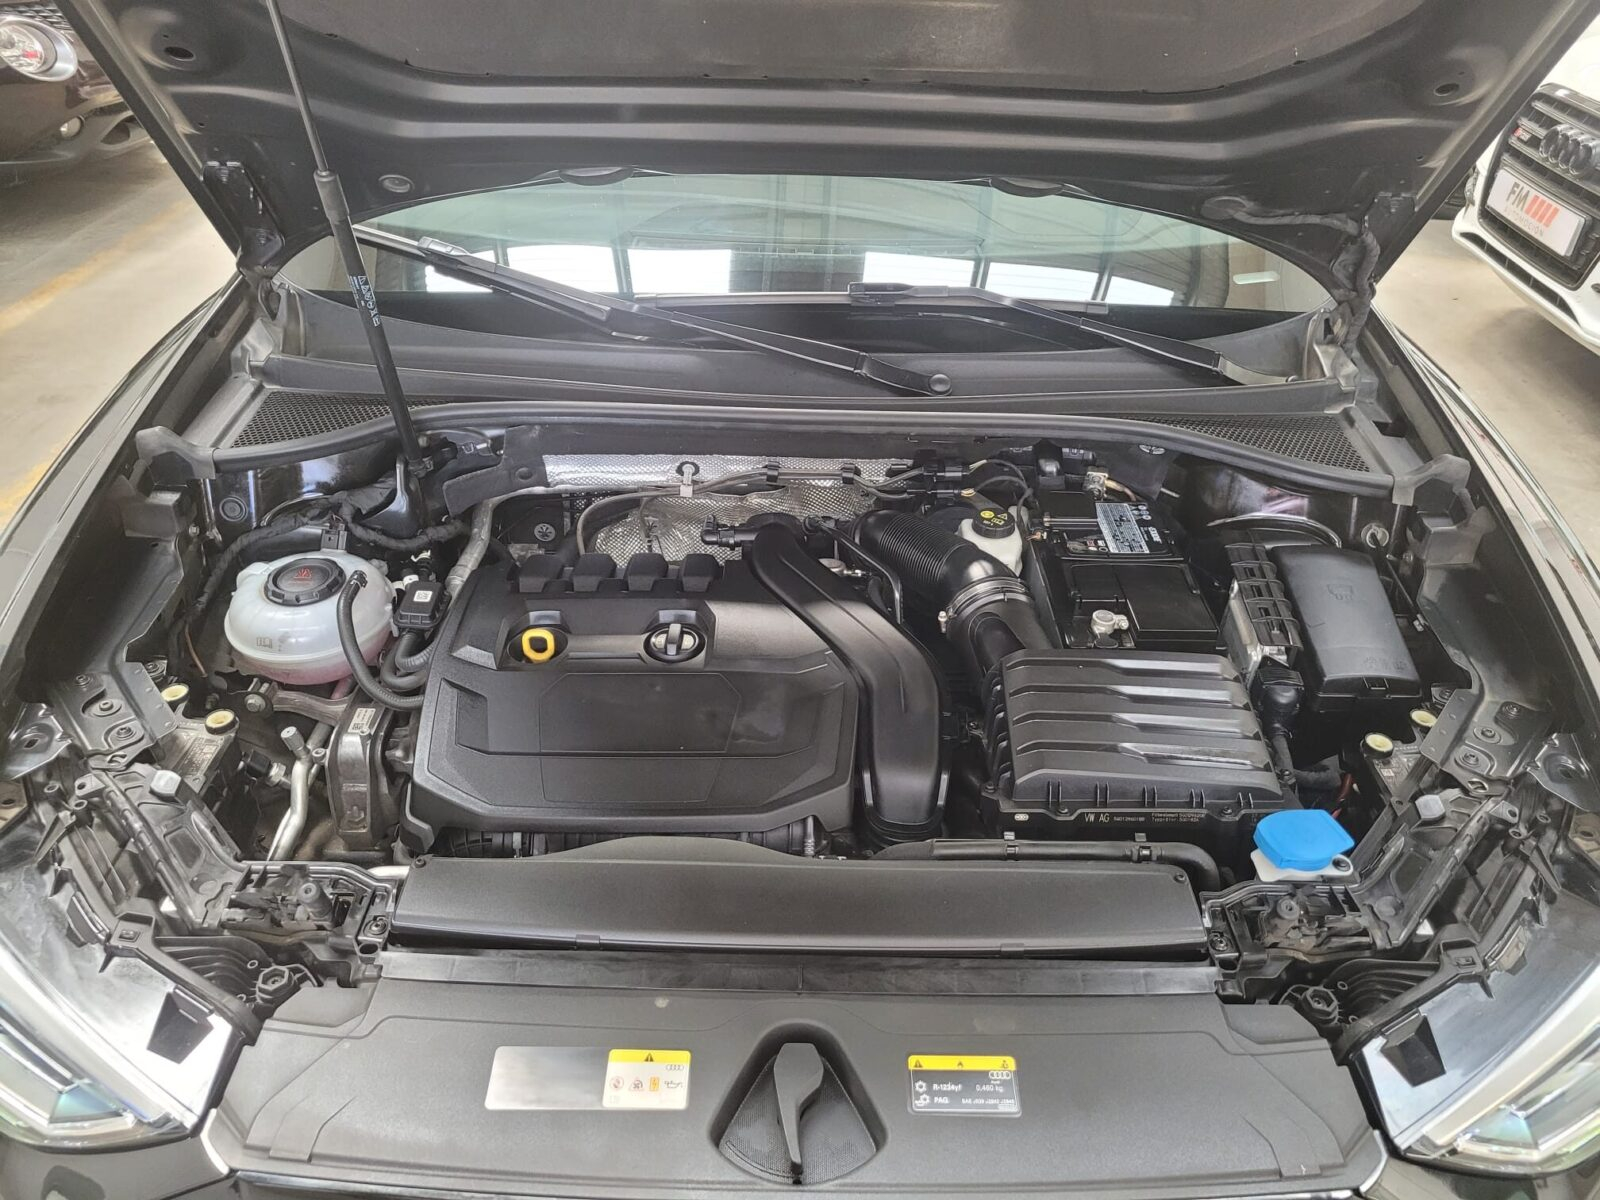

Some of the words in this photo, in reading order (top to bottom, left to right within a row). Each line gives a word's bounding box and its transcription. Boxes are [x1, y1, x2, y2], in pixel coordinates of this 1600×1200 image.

[1506, 182, 1531, 211] FM
[1084, 812, 1096, 822] VW
[1099, 812, 1110, 823] AG
[934, 1096, 951, 1104] PAG
